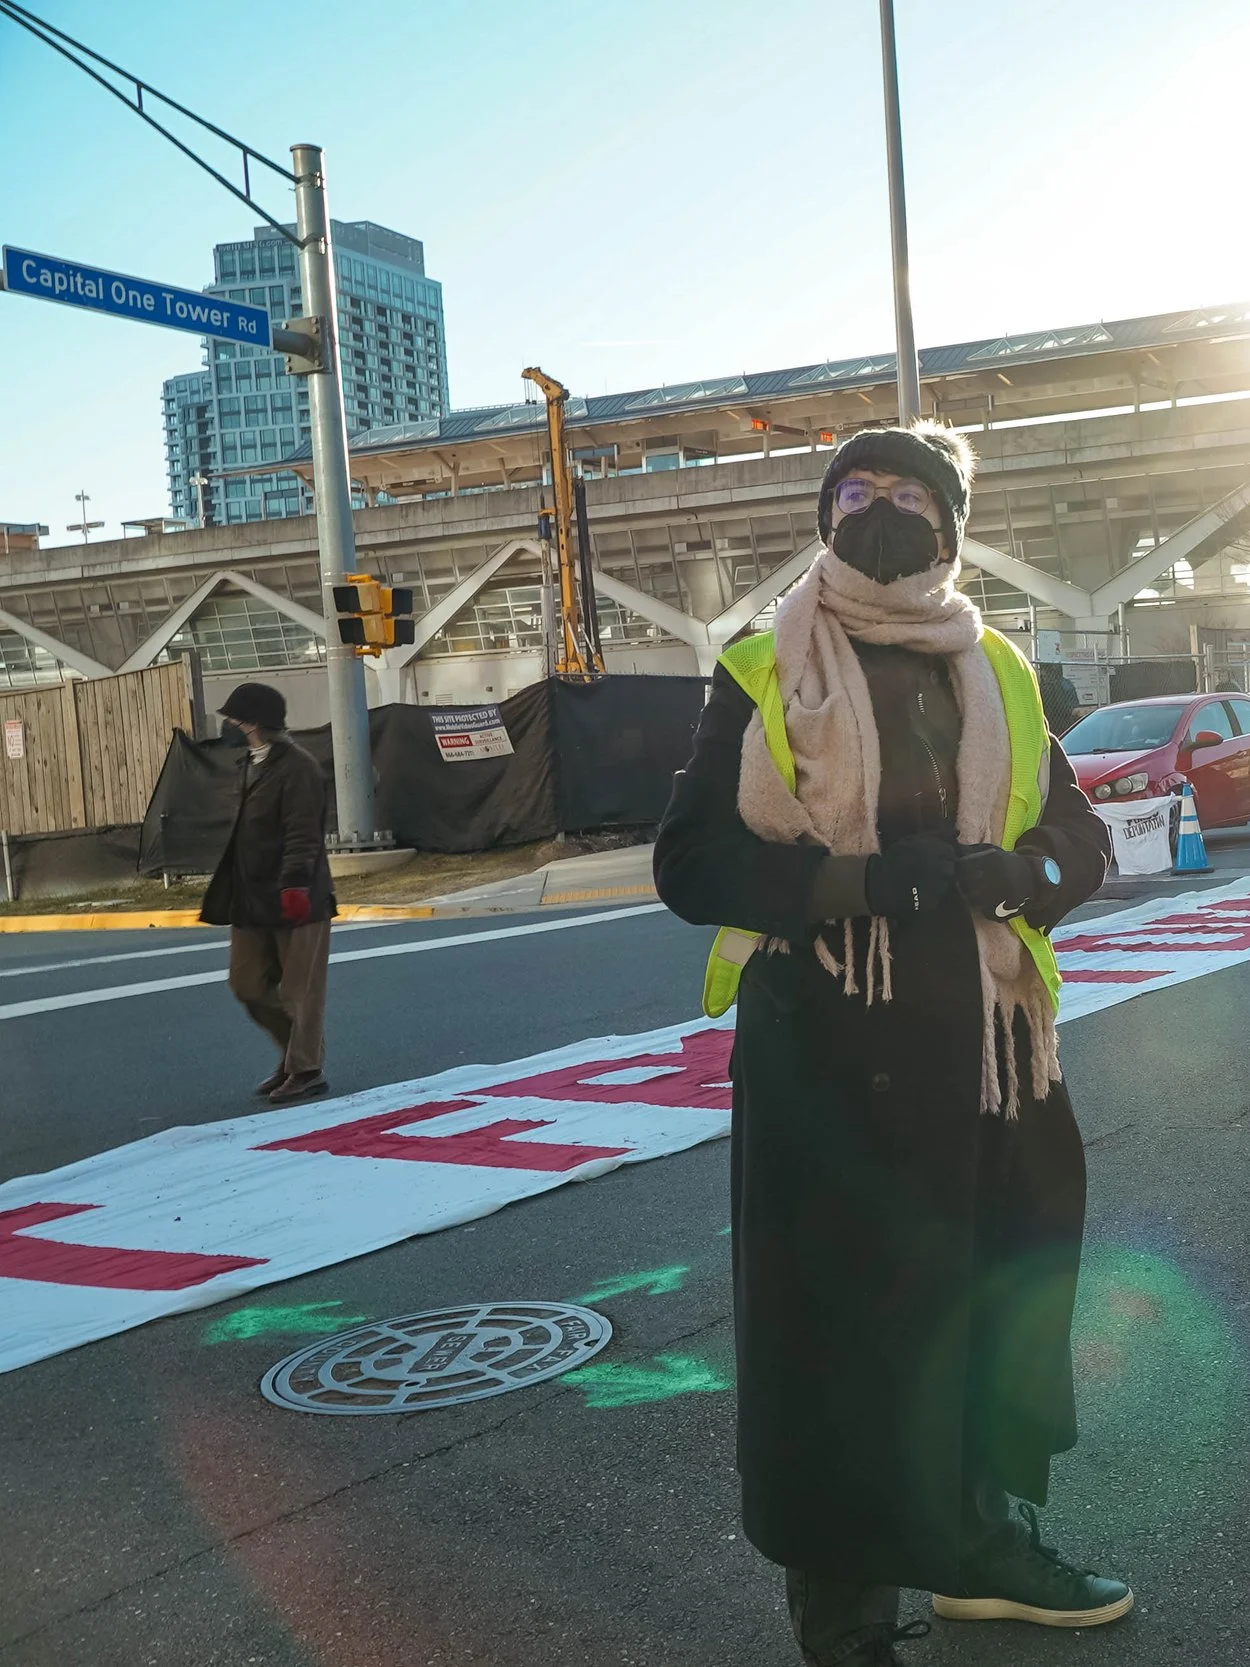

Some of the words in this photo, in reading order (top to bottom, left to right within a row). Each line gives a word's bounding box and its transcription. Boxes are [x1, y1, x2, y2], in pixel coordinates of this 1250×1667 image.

[22, 259, 104, 300] Capital
[111, 281, 155, 312] One
[162, 292, 232, 328] Tower
[238, 316, 257, 335] Rd
[431, 715, 444, 724] THIS
[444, 714, 455, 723] SITE
[455, 711, 488, 722] PROTECTED
[487, 708, 497, 717] BY
[440, 736, 470, 746] WARNING
[420, 1336, 467, 1371] SEWER
